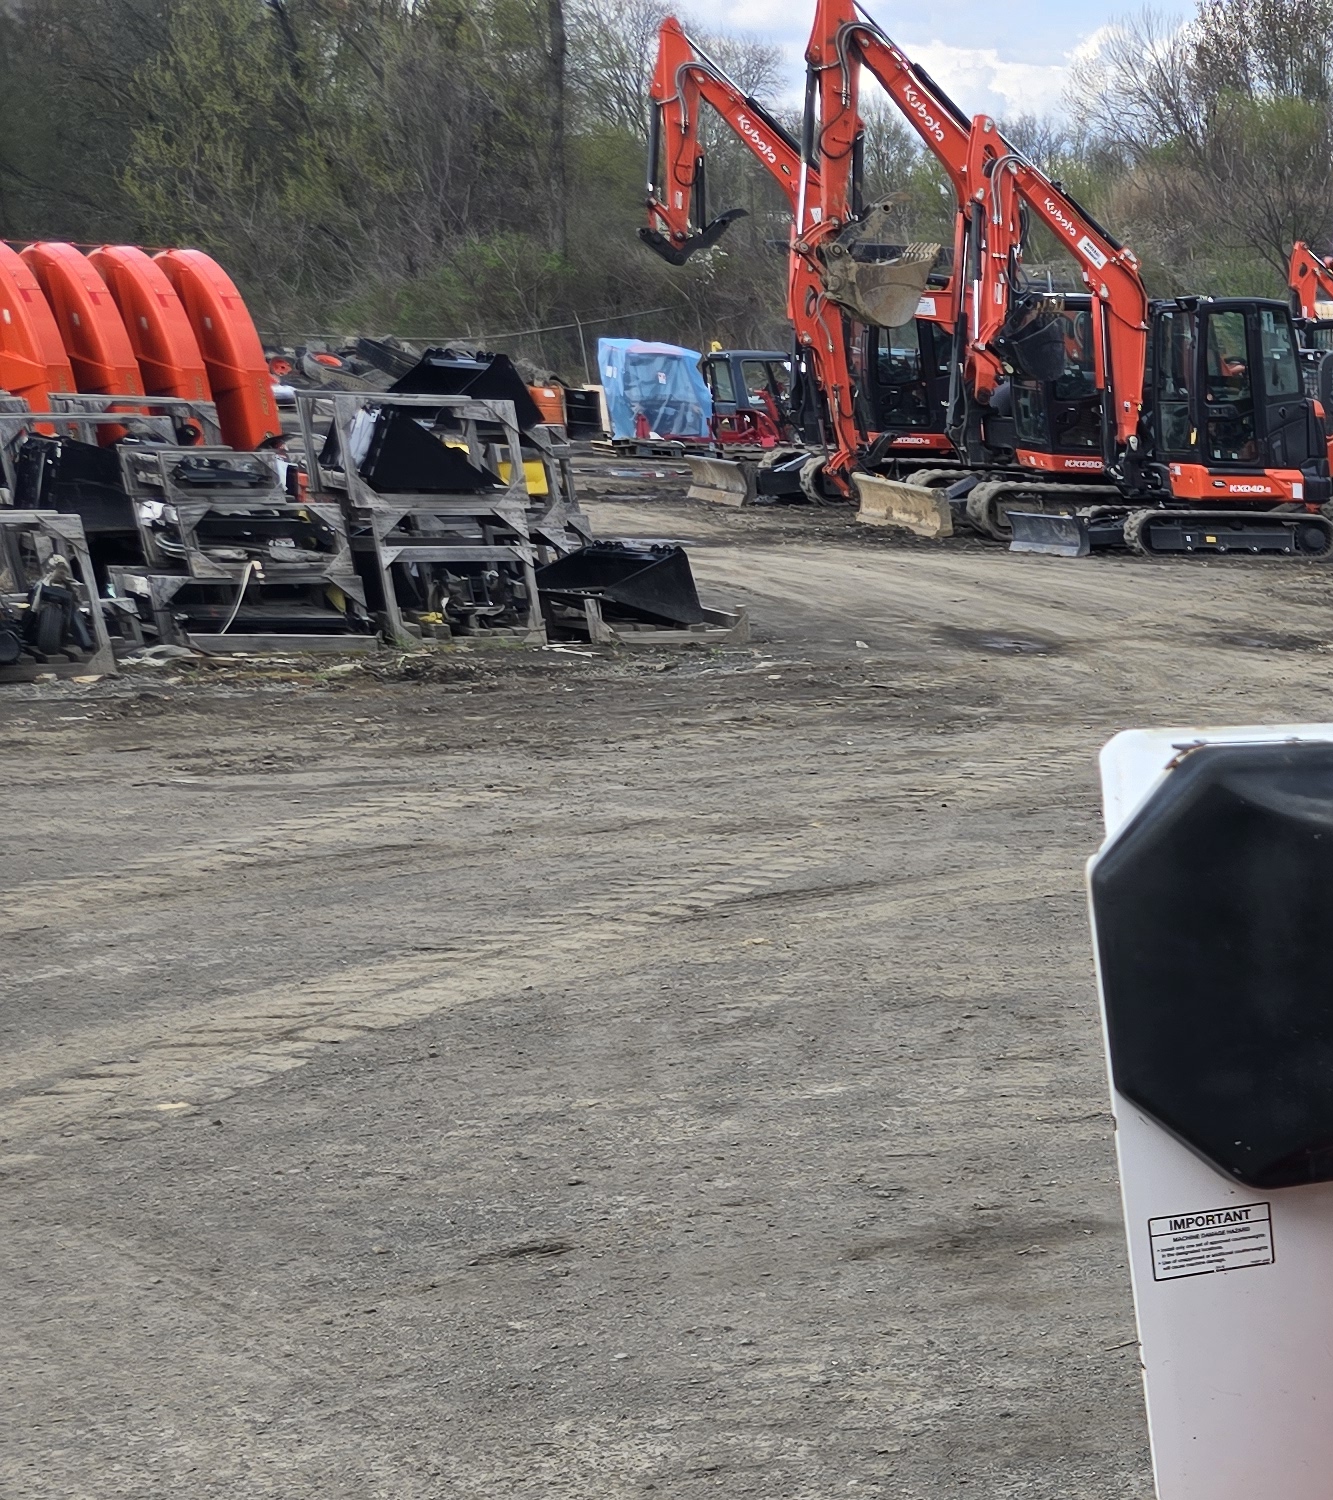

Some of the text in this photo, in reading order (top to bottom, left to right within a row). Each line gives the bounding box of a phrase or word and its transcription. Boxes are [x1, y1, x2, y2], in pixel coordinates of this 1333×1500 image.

[903, 85, 945, 143] Kubota
[737, 114, 777, 164] Kubota
[1044, 197, 1077, 237] Kubota
[1169, 1208, 1252, 1231] IMPORTANT
